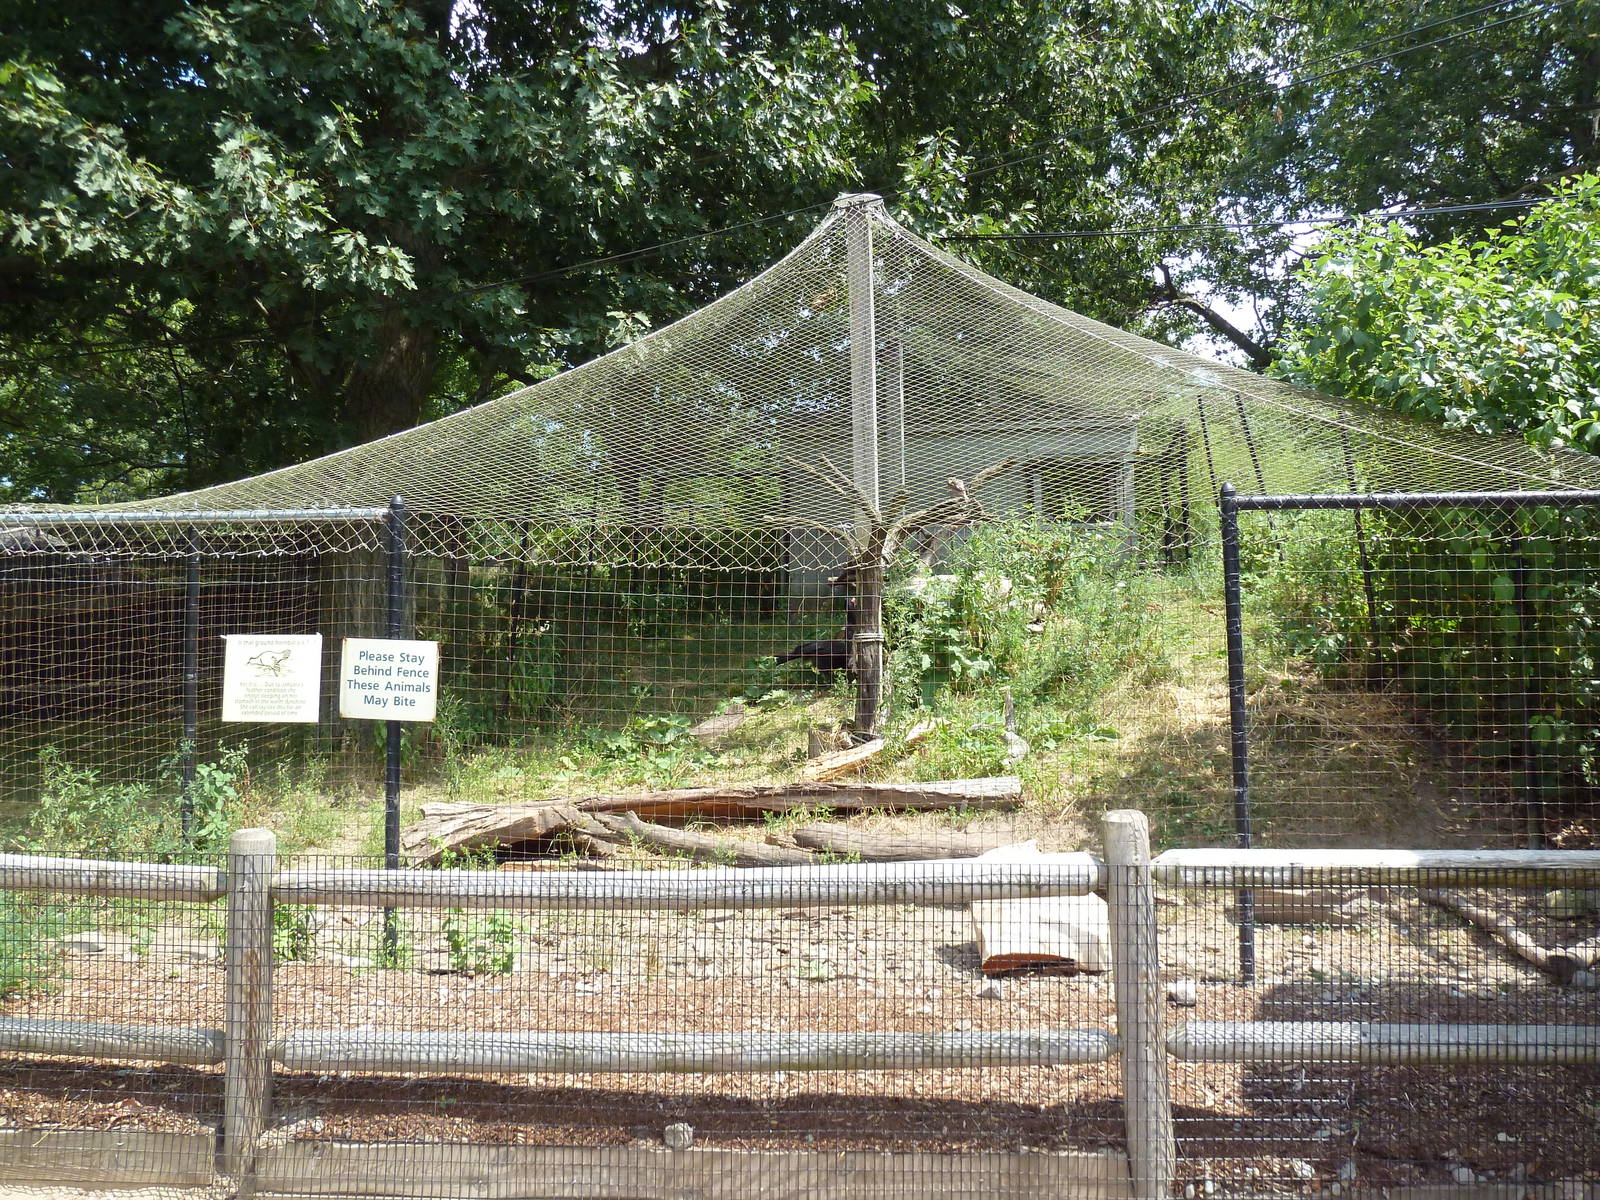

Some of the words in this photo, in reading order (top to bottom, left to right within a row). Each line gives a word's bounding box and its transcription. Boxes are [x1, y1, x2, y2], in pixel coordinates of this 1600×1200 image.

[359, 650, 395, 662] Please
[399, 652, 425, 665] Stay
[354, 665, 392, 676] Behind
[397, 667, 430, 678] Fence
[347, 679, 380, 690] These
[384, 681, 431, 693] Animals
[363, 695, 388, 708] May
[393, 696, 416, 707] Bite
